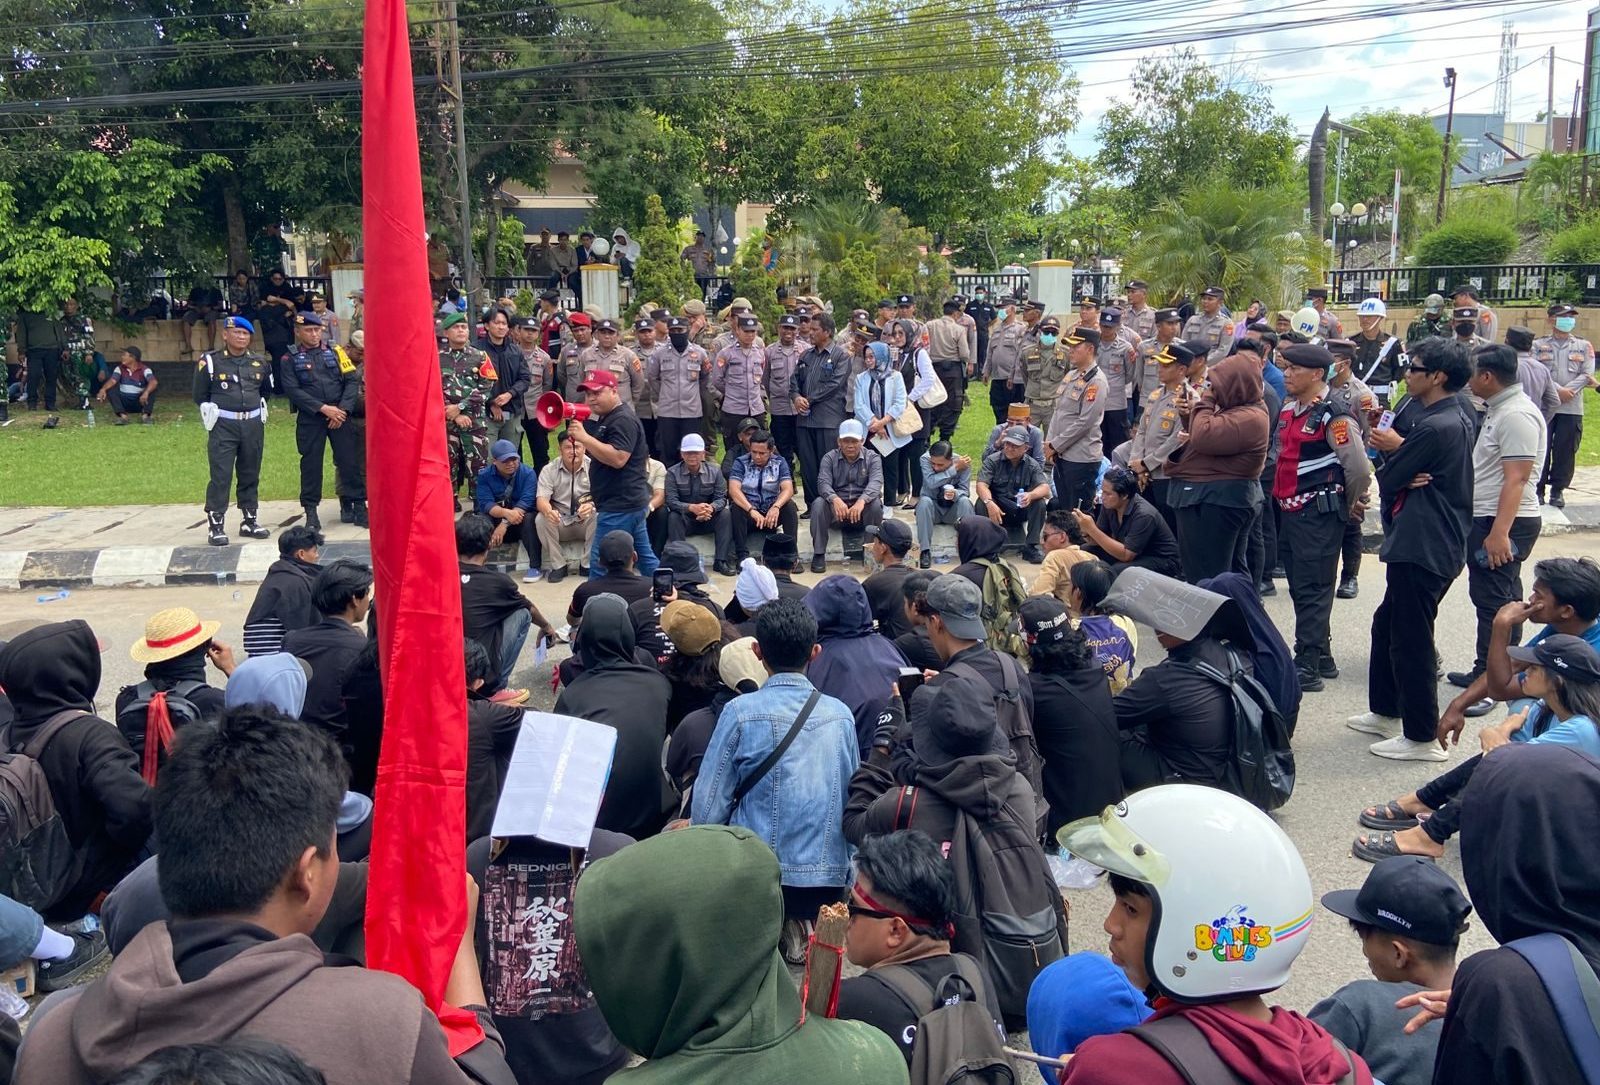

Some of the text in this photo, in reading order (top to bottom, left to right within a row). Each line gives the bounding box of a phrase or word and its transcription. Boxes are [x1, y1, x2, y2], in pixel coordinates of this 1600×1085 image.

[1361, 302, 1376, 312] PM
[1300, 322, 1314, 333] PM
[1377, 908, 1412, 929] BROOKLYN
[521, 896, 568, 982] 秋葉原
[1194, 923, 1272, 951] BUNNIES
[1212, 943, 1258, 962] CLUB
